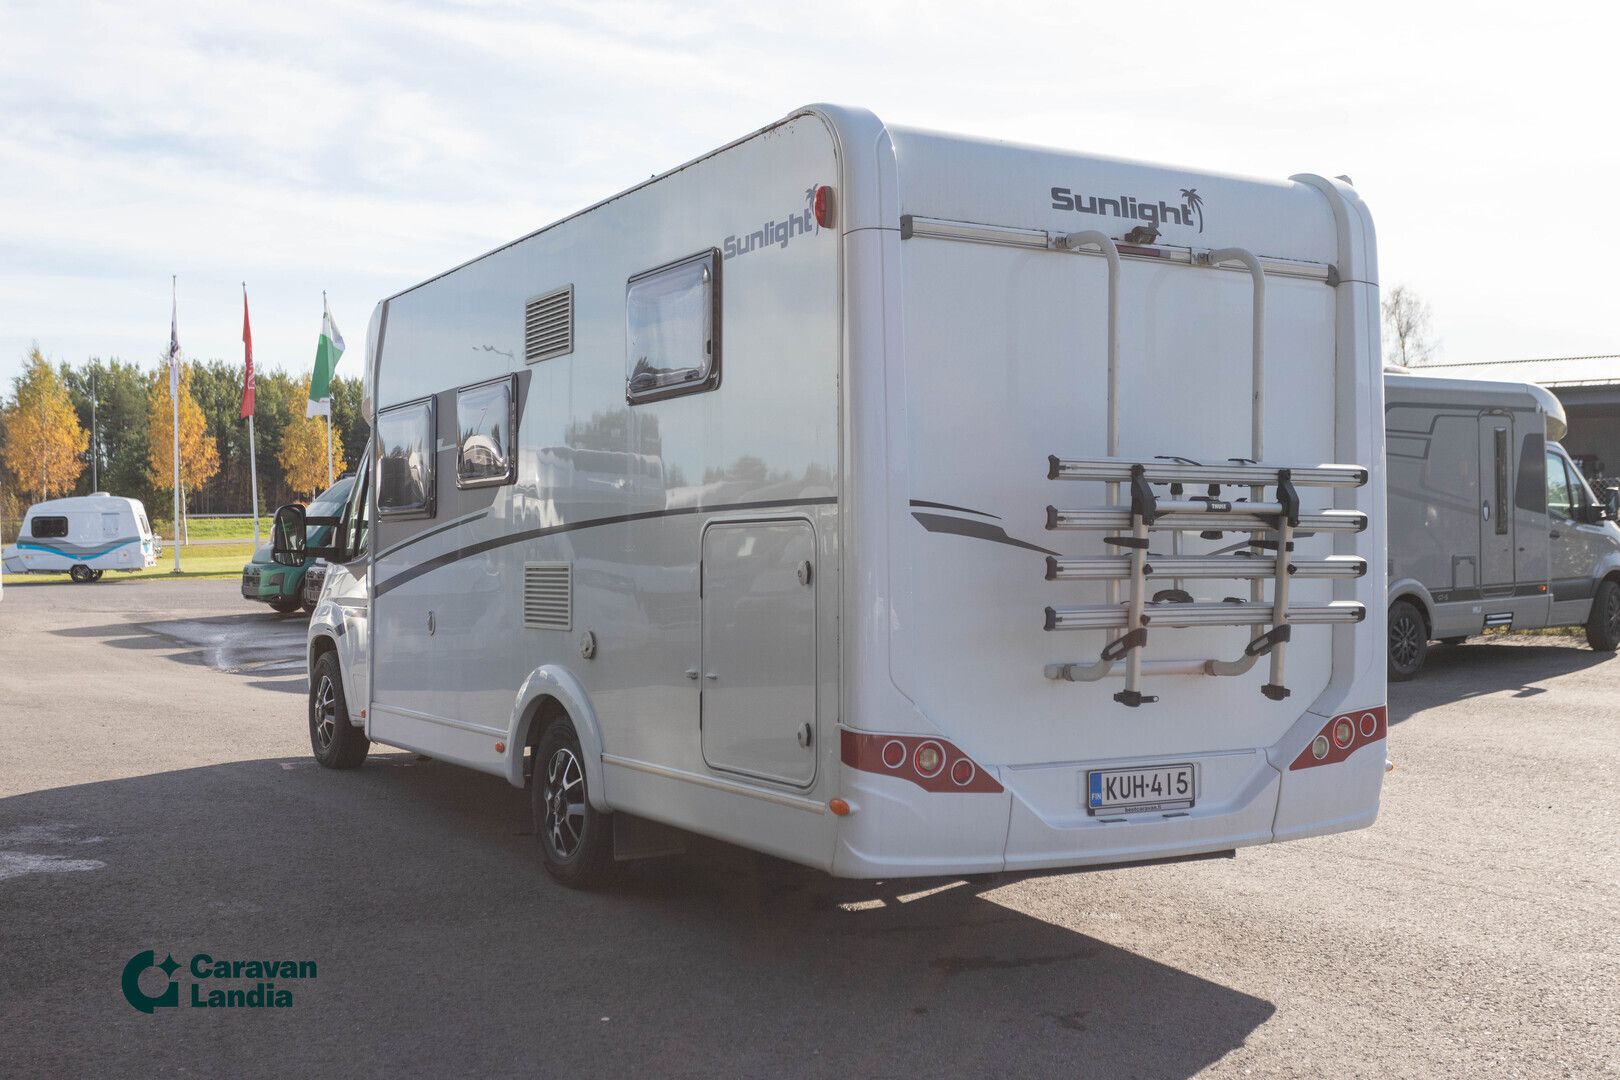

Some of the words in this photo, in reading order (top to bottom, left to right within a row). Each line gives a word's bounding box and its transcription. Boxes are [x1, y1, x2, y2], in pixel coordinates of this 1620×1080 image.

[1051, 187, 1194, 229] Sunlight
[723, 207, 813, 260] Sunlight
[1106, 772, 1188, 800] KUH-415
